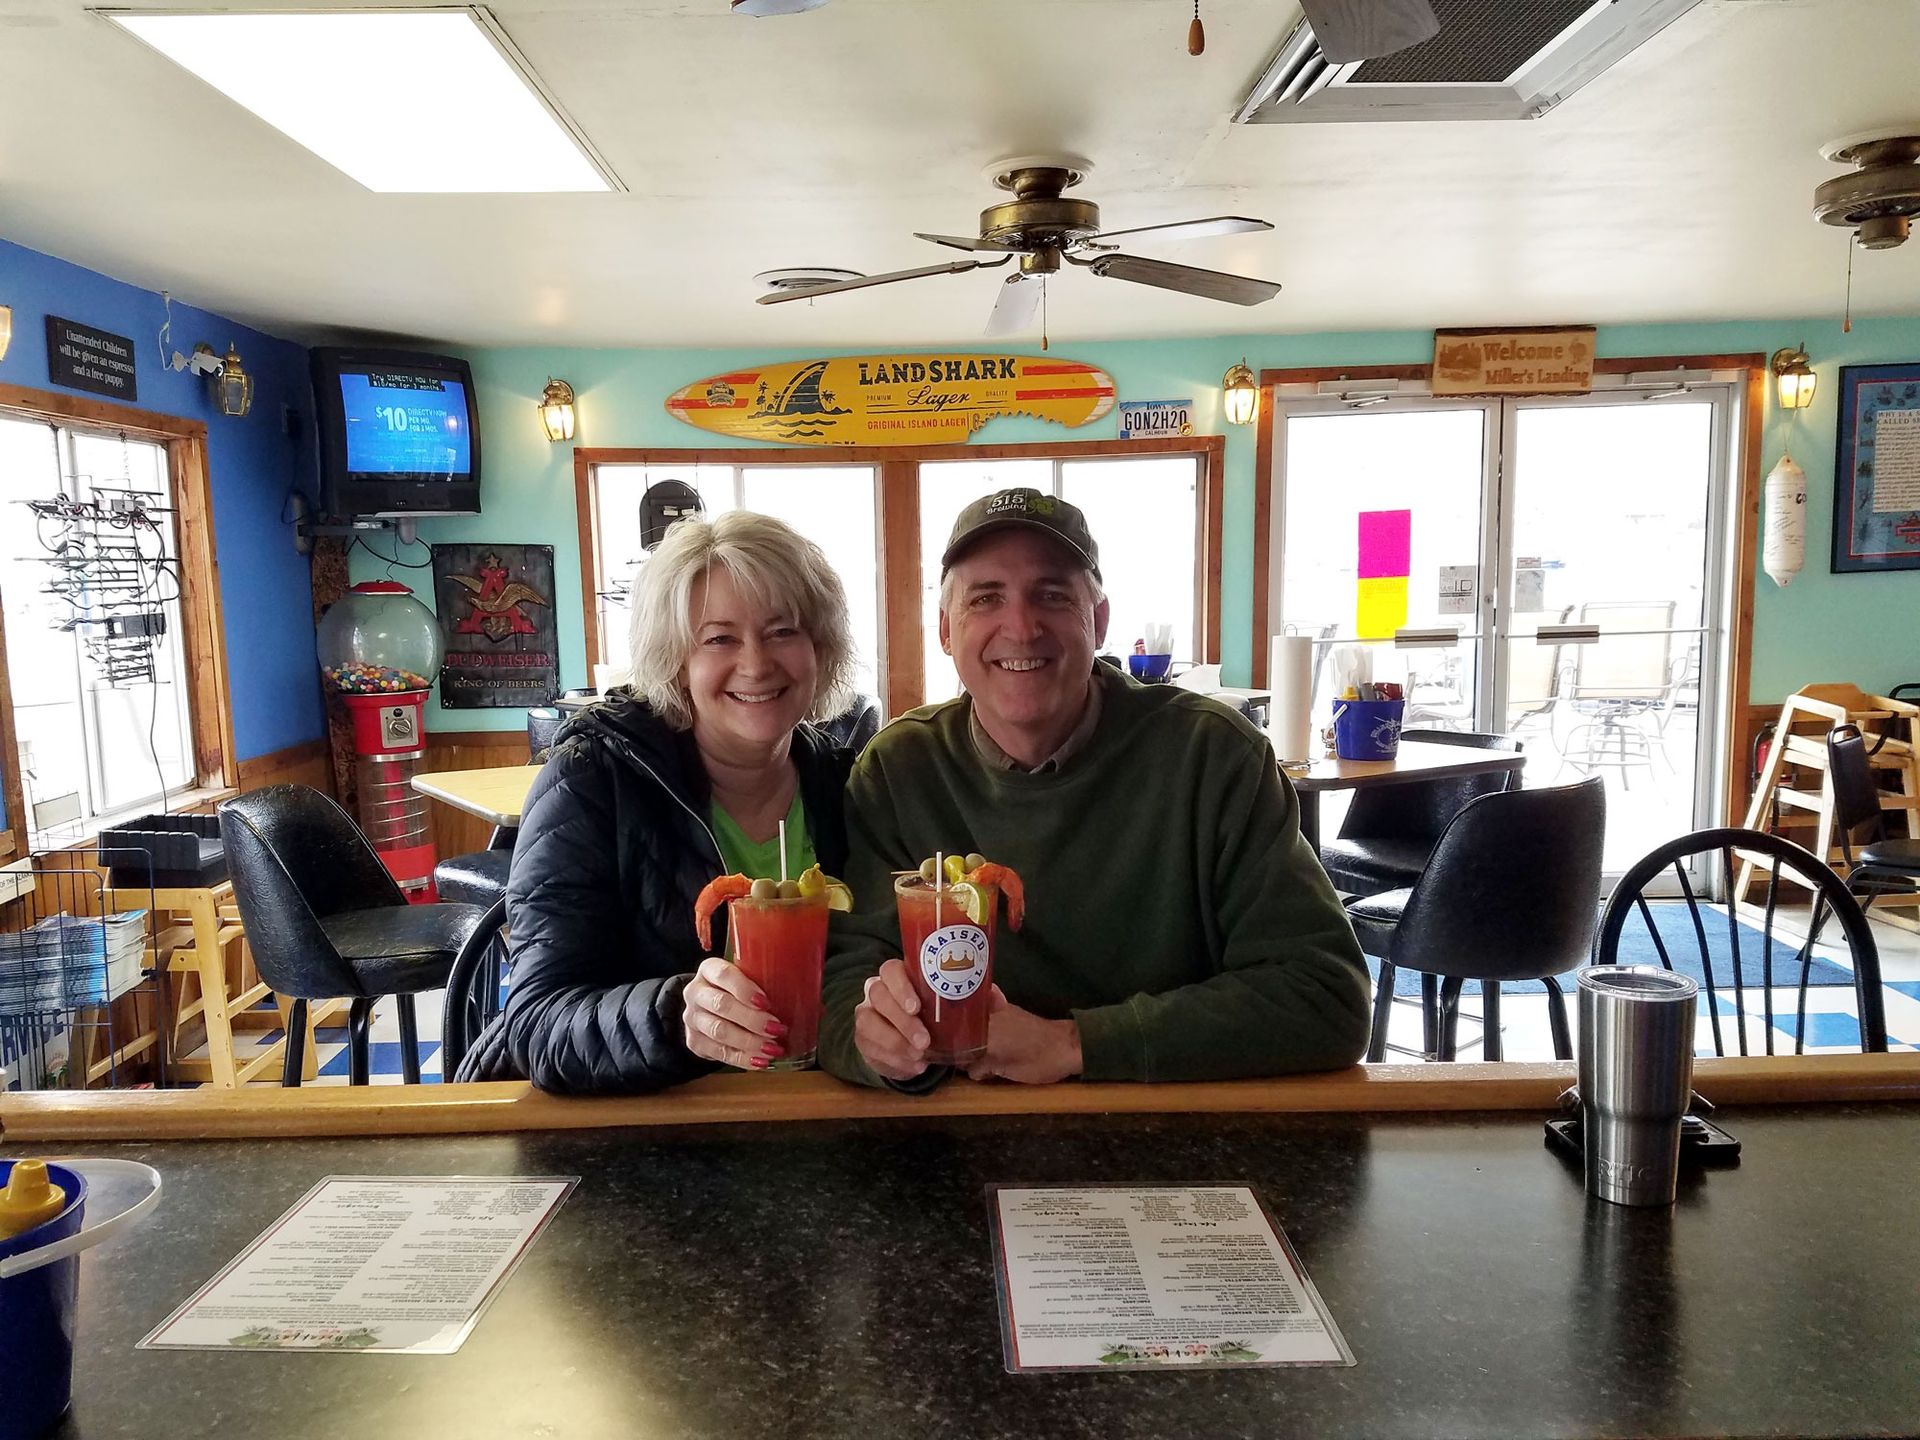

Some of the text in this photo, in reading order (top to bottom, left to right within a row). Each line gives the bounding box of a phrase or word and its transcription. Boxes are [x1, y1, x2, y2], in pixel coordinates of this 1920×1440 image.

[66, 330, 127, 357] Unattended Children
[1483, 340, 1563, 361] Welcome
[59, 344, 134, 374] will be given an espresso
[73, 364, 85, 376] and
[86, 369, 90, 377] a
[92, 367, 104, 380] free
[859, 358, 1016, 385] LANDSHARK
[1485, 366, 1589, 387] Miller's Landing
[907, 385, 971, 412] Lager
[375, 406, 407, 432] $10
[408, 408, 433, 416] DIRECTV
[868, 419, 906, 429] ORIGINAL
[908, 418, 937, 428] ISLAND
[940, 417, 966, 427] LAGER
[986, 504, 1026, 515] Brewing
[991, 494, 1024, 508] 515
[454, 680, 484, 688] KING
[508, 680, 545, 688] BEERS
[928, 930, 985, 955] RAISED
[930, 969, 983, 993] ROYAL
